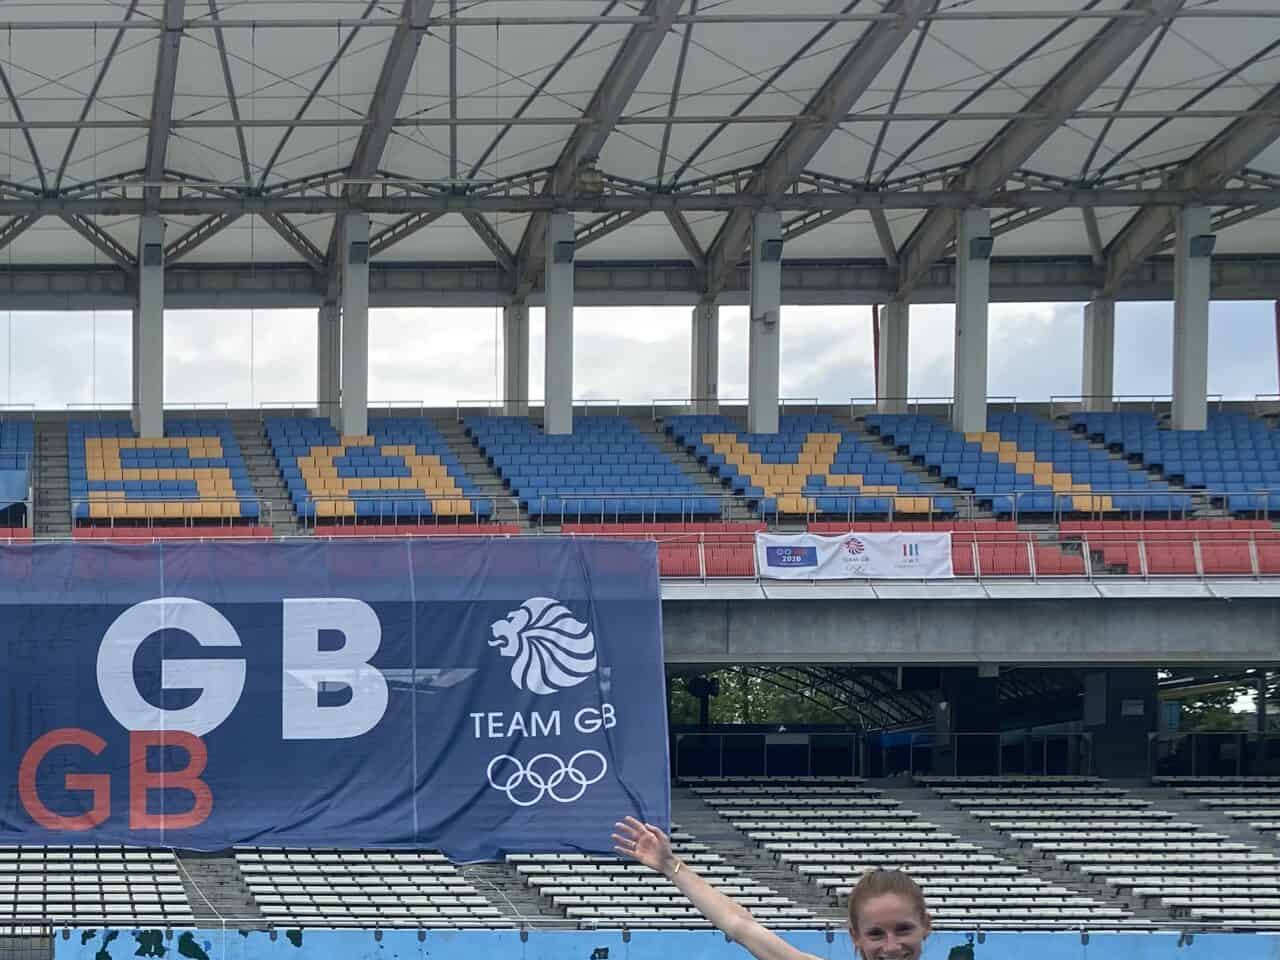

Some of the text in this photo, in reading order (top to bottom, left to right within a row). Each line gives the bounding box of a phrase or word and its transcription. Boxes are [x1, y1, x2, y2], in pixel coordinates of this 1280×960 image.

[96, 596, 389, 740] GB
[470, 703, 617, 738] TEAM GB
